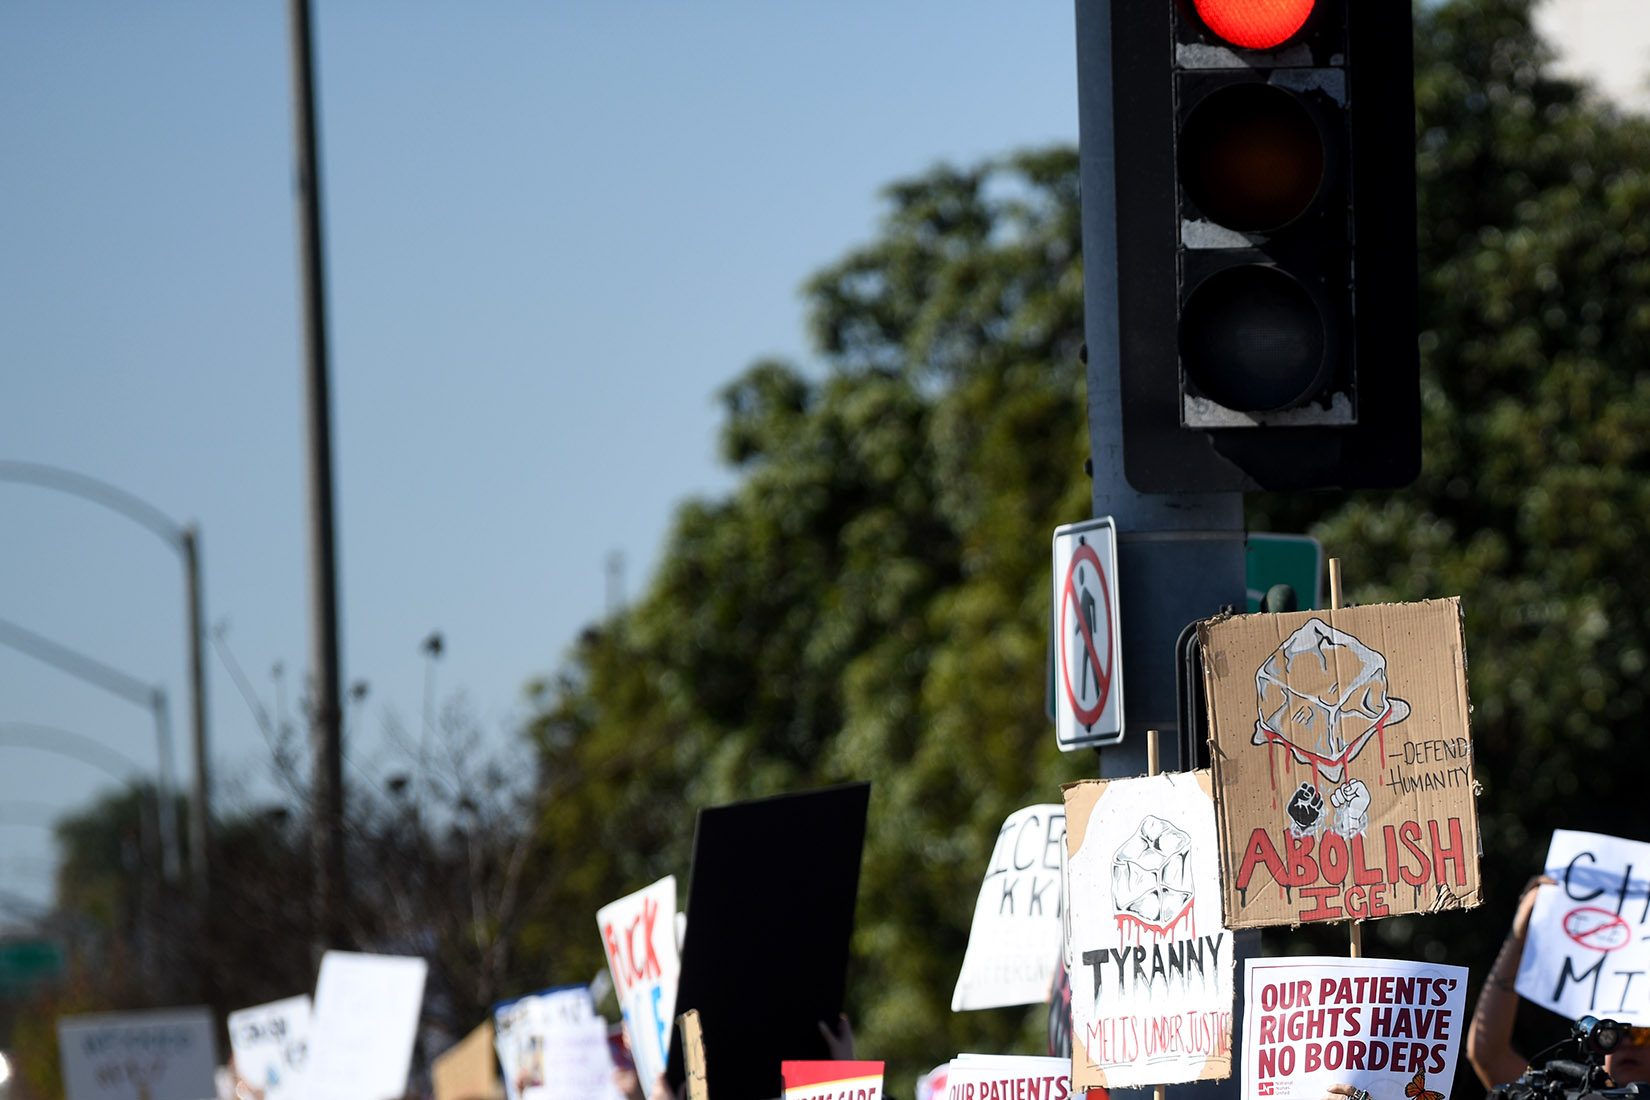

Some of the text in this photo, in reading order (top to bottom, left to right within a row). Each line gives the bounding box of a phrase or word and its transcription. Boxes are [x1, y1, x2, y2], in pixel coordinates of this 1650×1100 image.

[1386, 763, 1471, 796] HUMANITY
[1236, 817, 1467, 889] ABOLISH
[1000, 876, 1063, 918] KK
[1299, 884, 1390, 922] ICE
[604, 897, 661, 1000] FUCK
[1082, 933, 1224, 1001] TYRANNY
[1261, 976, 1457, 1012] OUR PATIENTS'
[1086, 1015, 1139, 1065] MELTS
[1144, 1013, 1184, 1057] UNDER
[1259, 1007, 1452, 1045] RIGHTS HAVE
[1258, 1040, 1447, 1079] NO BORDERS
